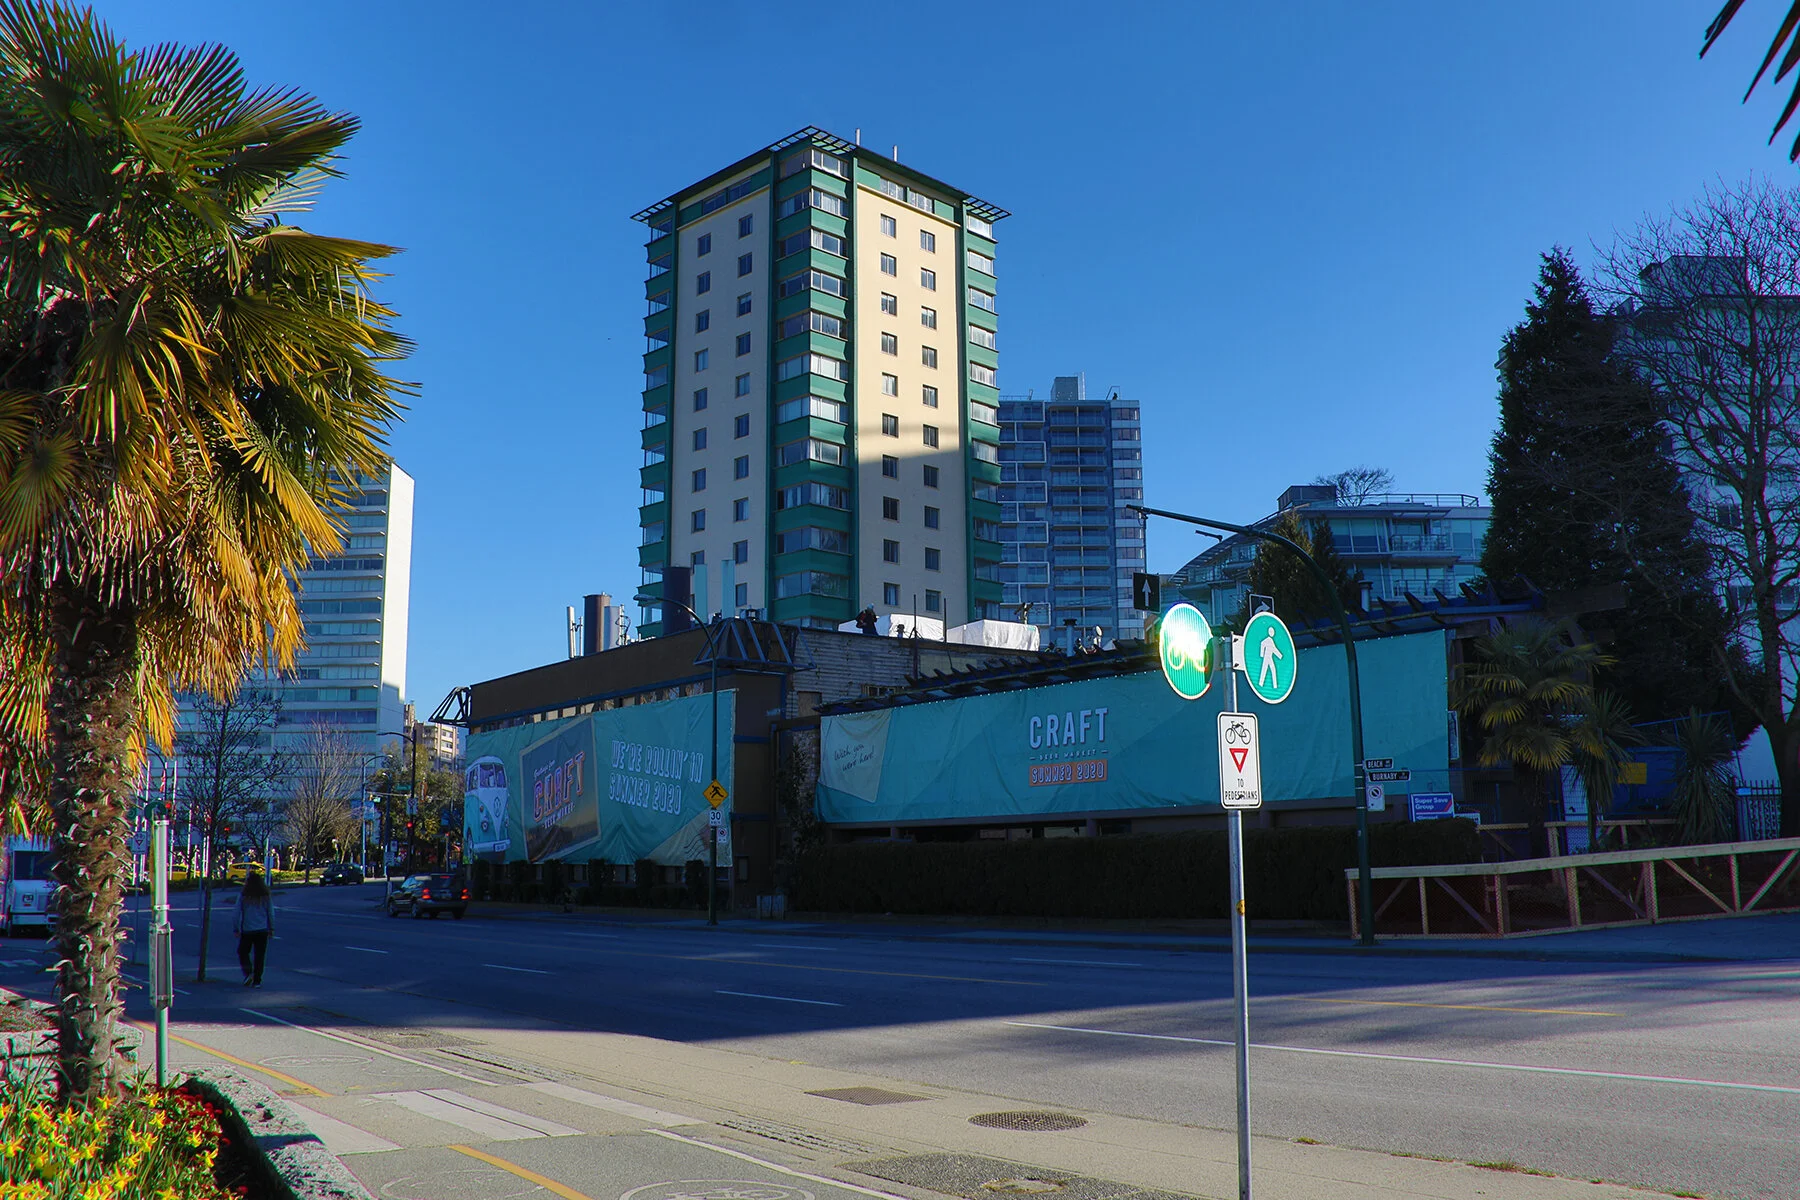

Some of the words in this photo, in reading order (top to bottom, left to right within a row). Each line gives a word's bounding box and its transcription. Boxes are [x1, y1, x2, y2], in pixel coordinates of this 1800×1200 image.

[1029, 707, 1109, 750] CRAFT
[611, 740, 643, 773] WE'RE
[645, 745, 688, 780] ROLLIN'
[689, 752, 703, 783] IN
[1367, 760, 1384, 769] BEACH
[1031, 764, 1073, 784] SUMMER
[1076, 761, 1105, 781] 2020
[1372, 772, 1398, 781] BURNABY
[533, 751, 586, 823] CRAFT
[1237, 778, 1245, 788] TO
[609, 772, 651, 808] SUMMER
[652, 780, 682, 815] 2020
[1414, 797, 1433, 805] Super
[710, 811, 721, 820] 30
